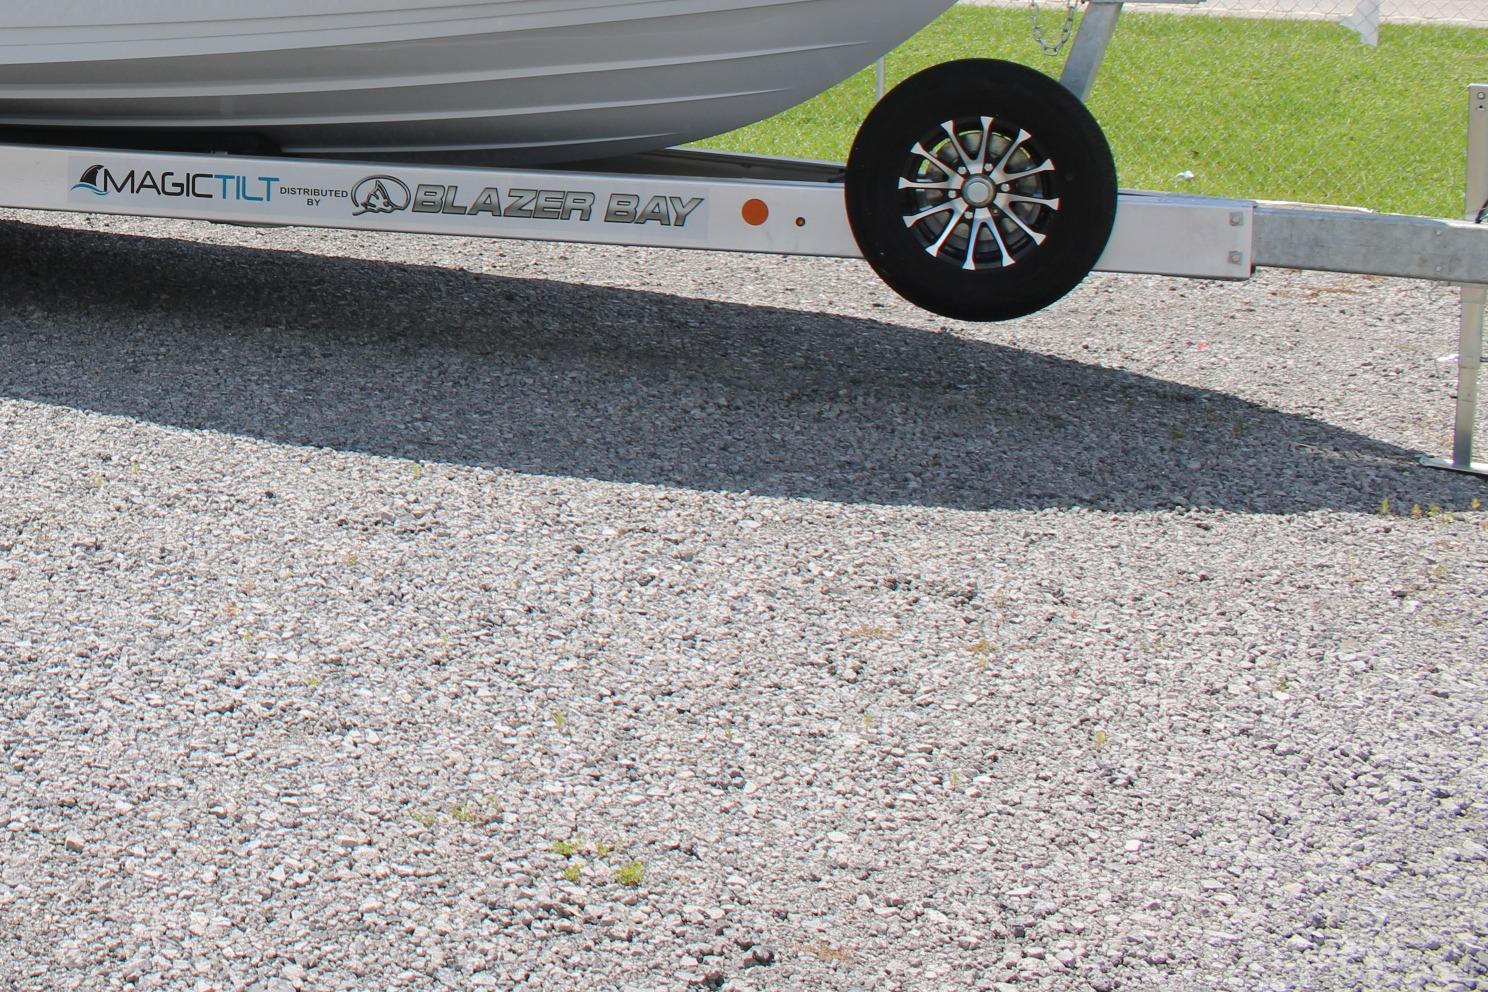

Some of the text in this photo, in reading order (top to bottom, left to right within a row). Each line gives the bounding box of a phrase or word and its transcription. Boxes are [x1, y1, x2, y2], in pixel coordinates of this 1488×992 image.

[103, 168, 280, 202] MAGICTILT
[279, 186, 349, 199] DISTRIBUTED
[306, 198, 321, 207] BY
[412, 183, 704, 227] BLAZER BAY
